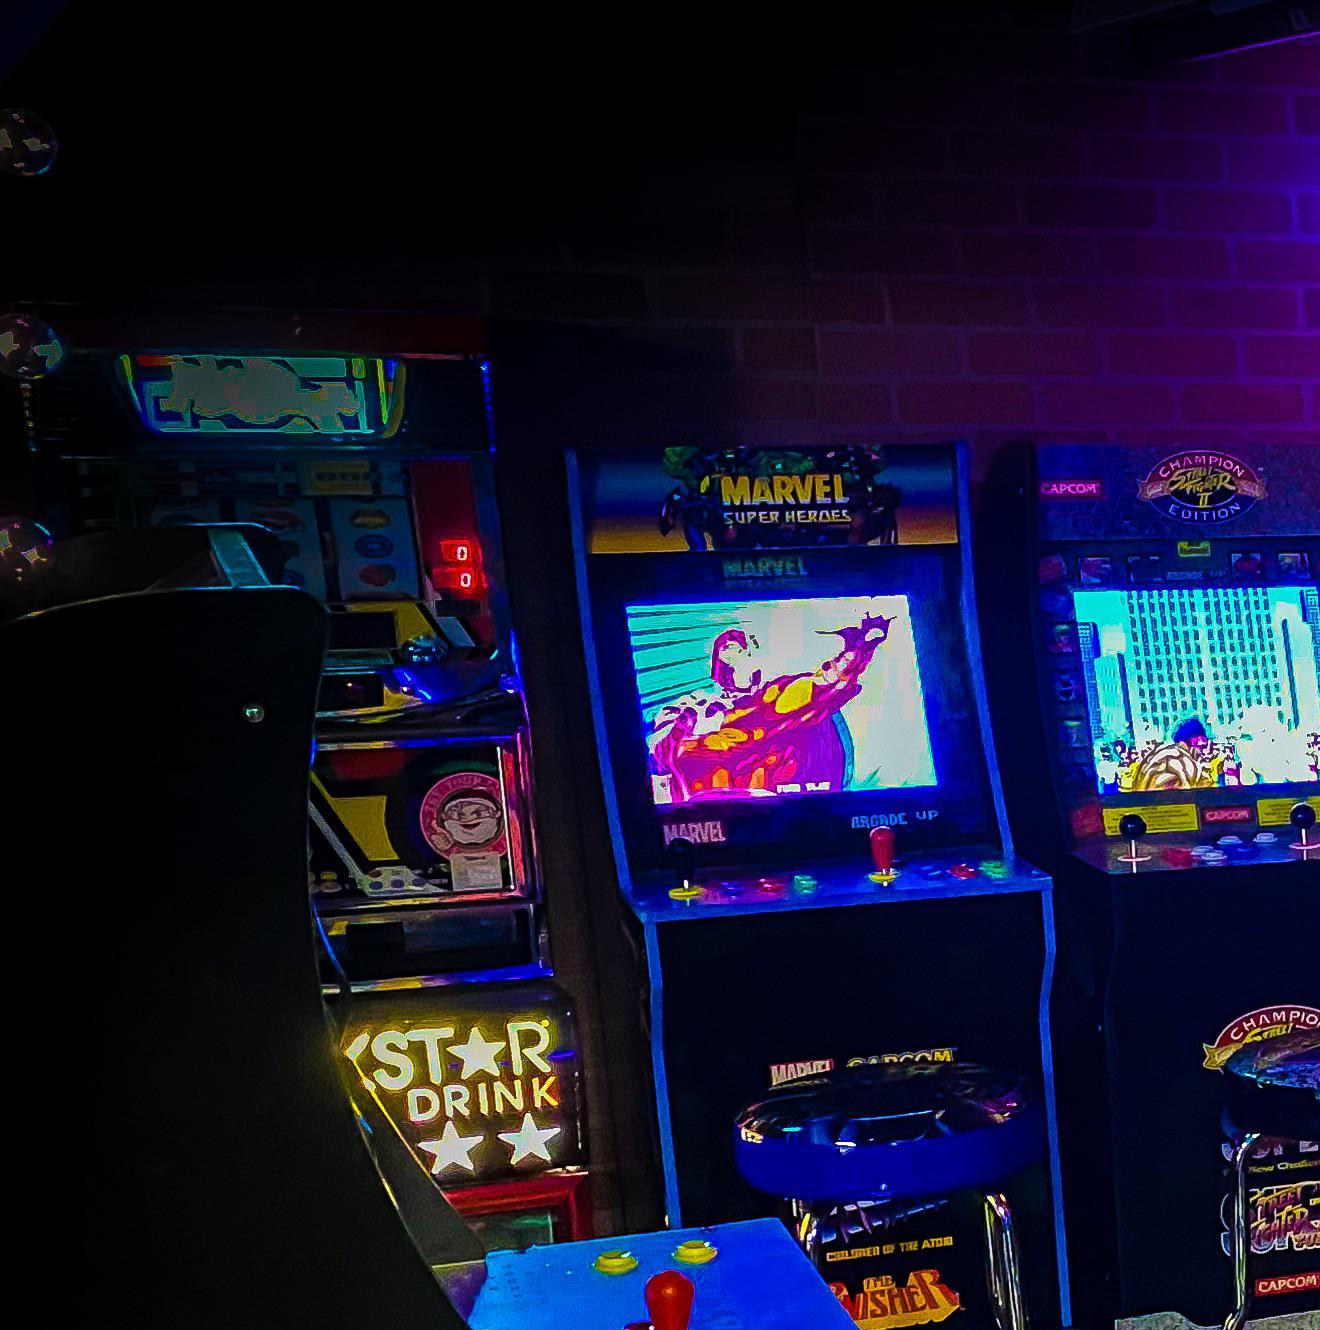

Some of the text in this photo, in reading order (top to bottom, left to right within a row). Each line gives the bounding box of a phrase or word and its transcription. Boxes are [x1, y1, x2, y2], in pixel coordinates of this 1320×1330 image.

[1159, 455, 1245, 478] CHAMPION
[721, 474, 850, 506] MARVEL
[1041, 482, 1097, 495] CAPCOM
[723, 509, 852, 525] SUPER HEROES
[1168, 502, 1241, 521] EDITION
[662, 820, 727, 848] MARVEL
[406, 1075, 560, 1124] DRINK
[863, 1275, 895, 1291] THE
[1258, 1274, 1317, 1293] CAPCOM
